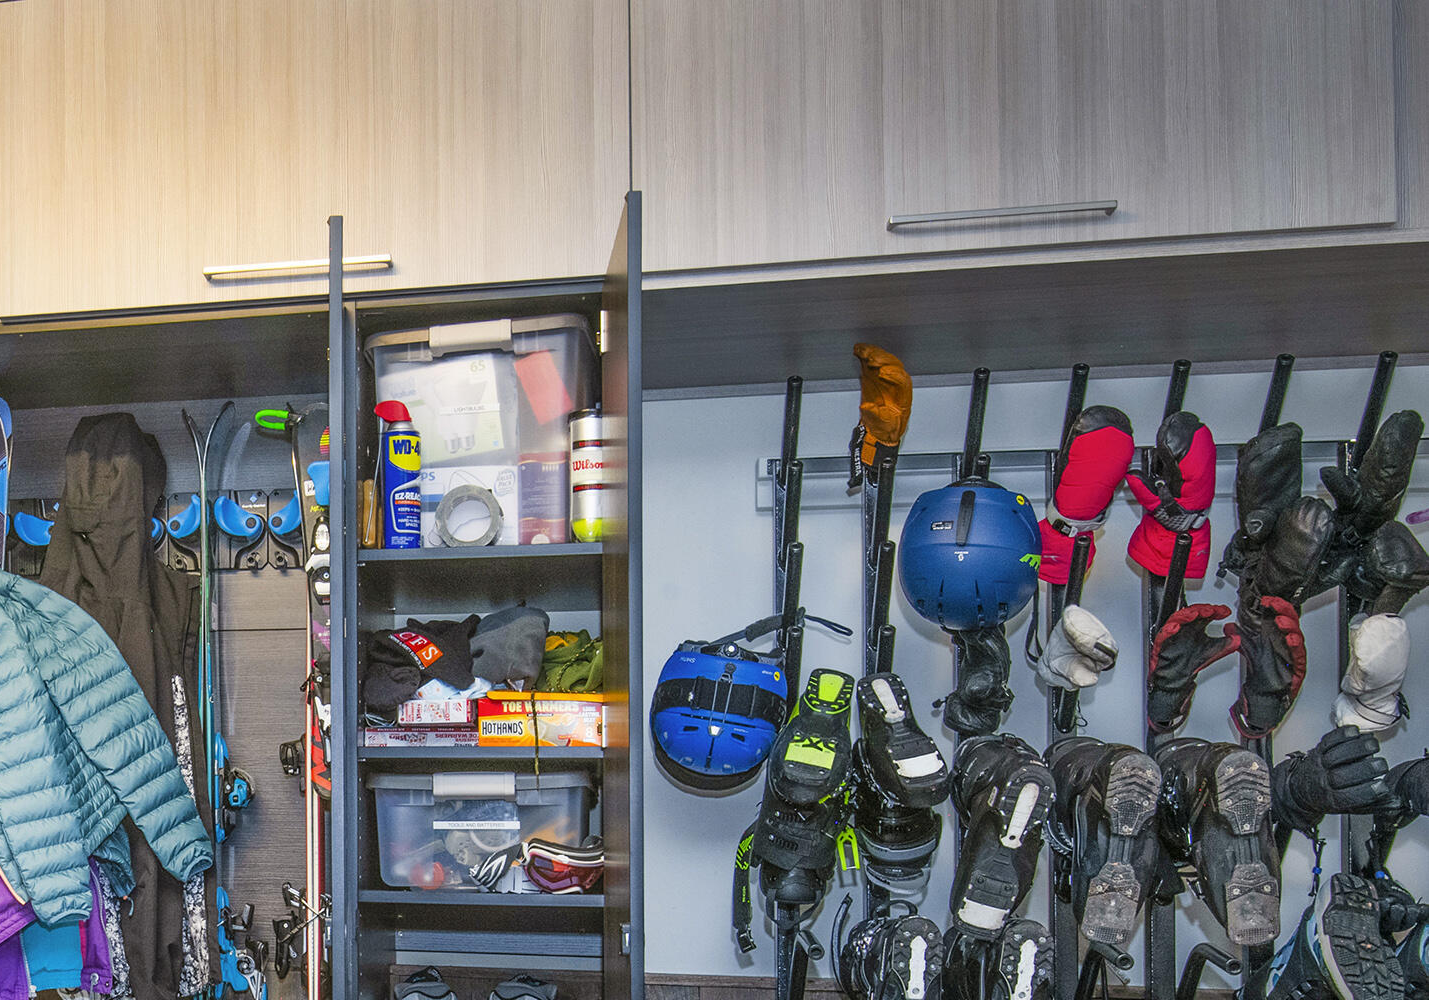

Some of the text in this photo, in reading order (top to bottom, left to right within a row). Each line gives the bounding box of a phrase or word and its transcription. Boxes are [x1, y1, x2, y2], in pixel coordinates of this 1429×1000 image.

[393, 439, 420, 456] WD-4
[502, 700, 580, 713] TOE WARMERS
[481, 720, 524, 736] HOTHANDS
